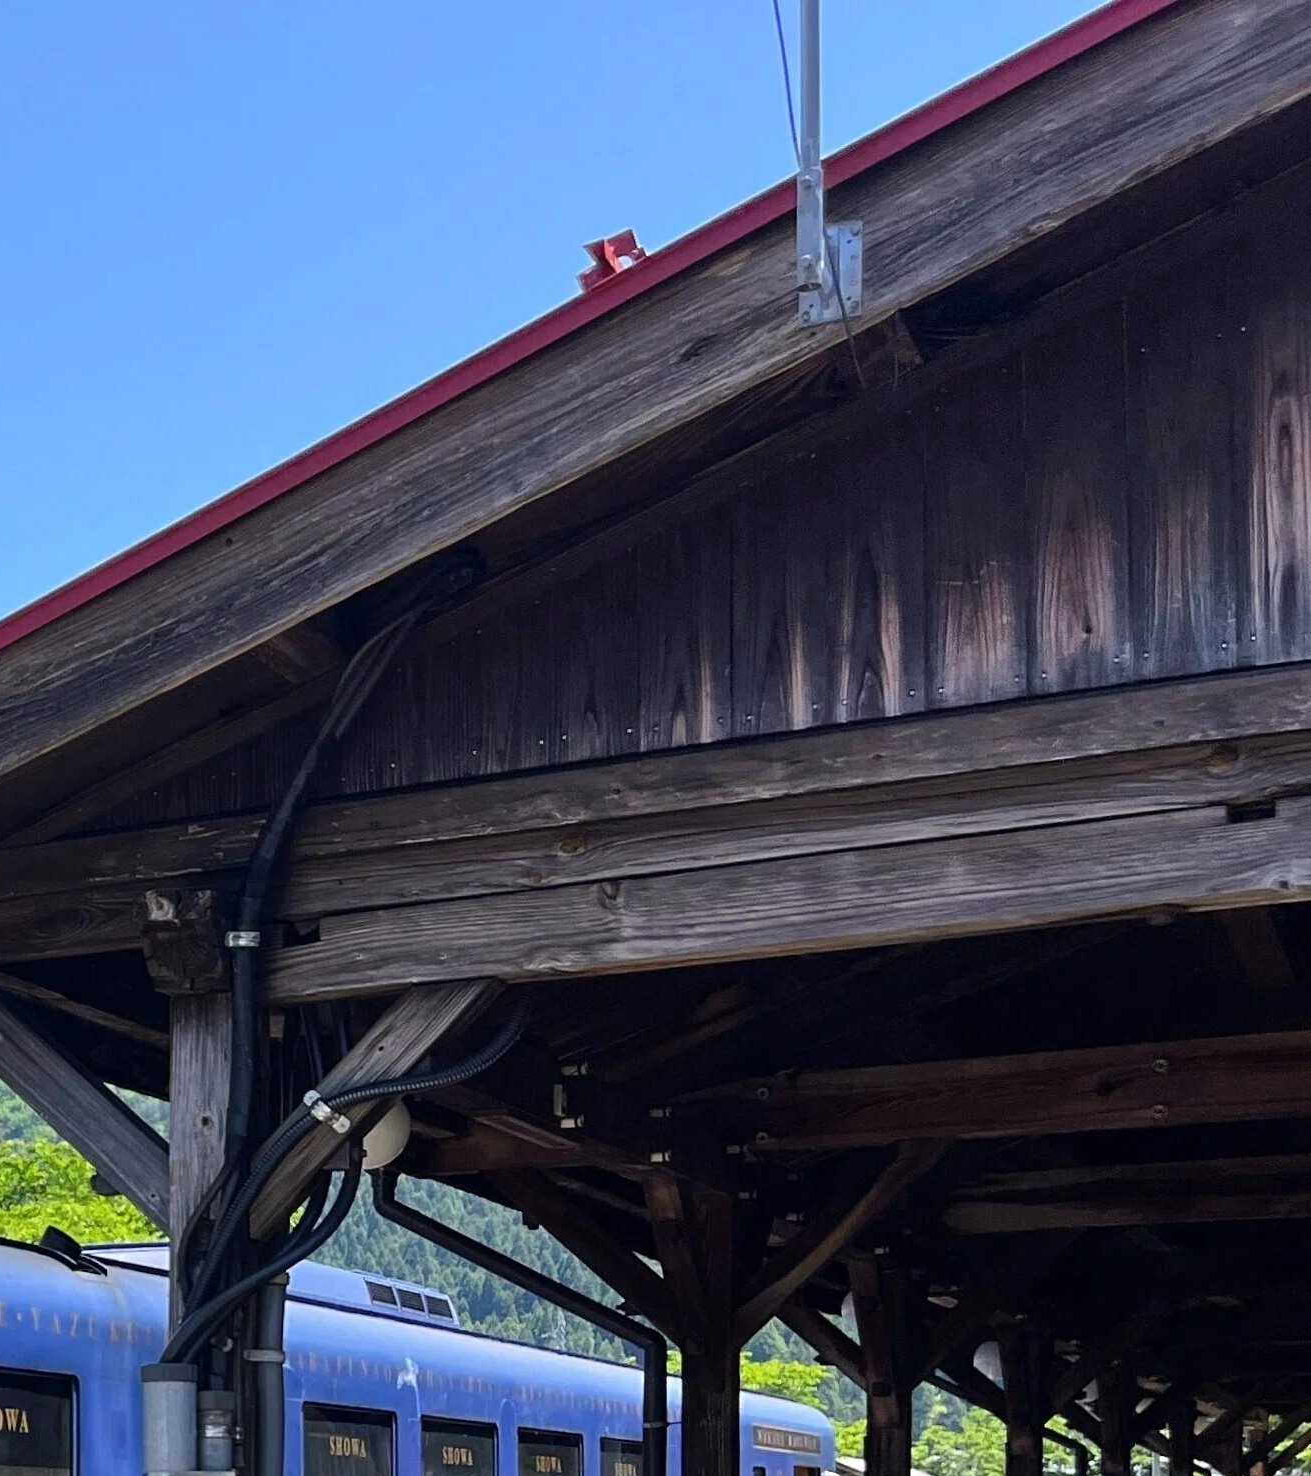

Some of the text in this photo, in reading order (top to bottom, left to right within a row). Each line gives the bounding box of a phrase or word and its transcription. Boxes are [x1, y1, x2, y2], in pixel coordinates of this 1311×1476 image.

[329, 1435, 367, 1459] SHOWA
[441, 1446, 474, 1467] SHOWA
[535, 1455, 562, 1474] SHOWA
